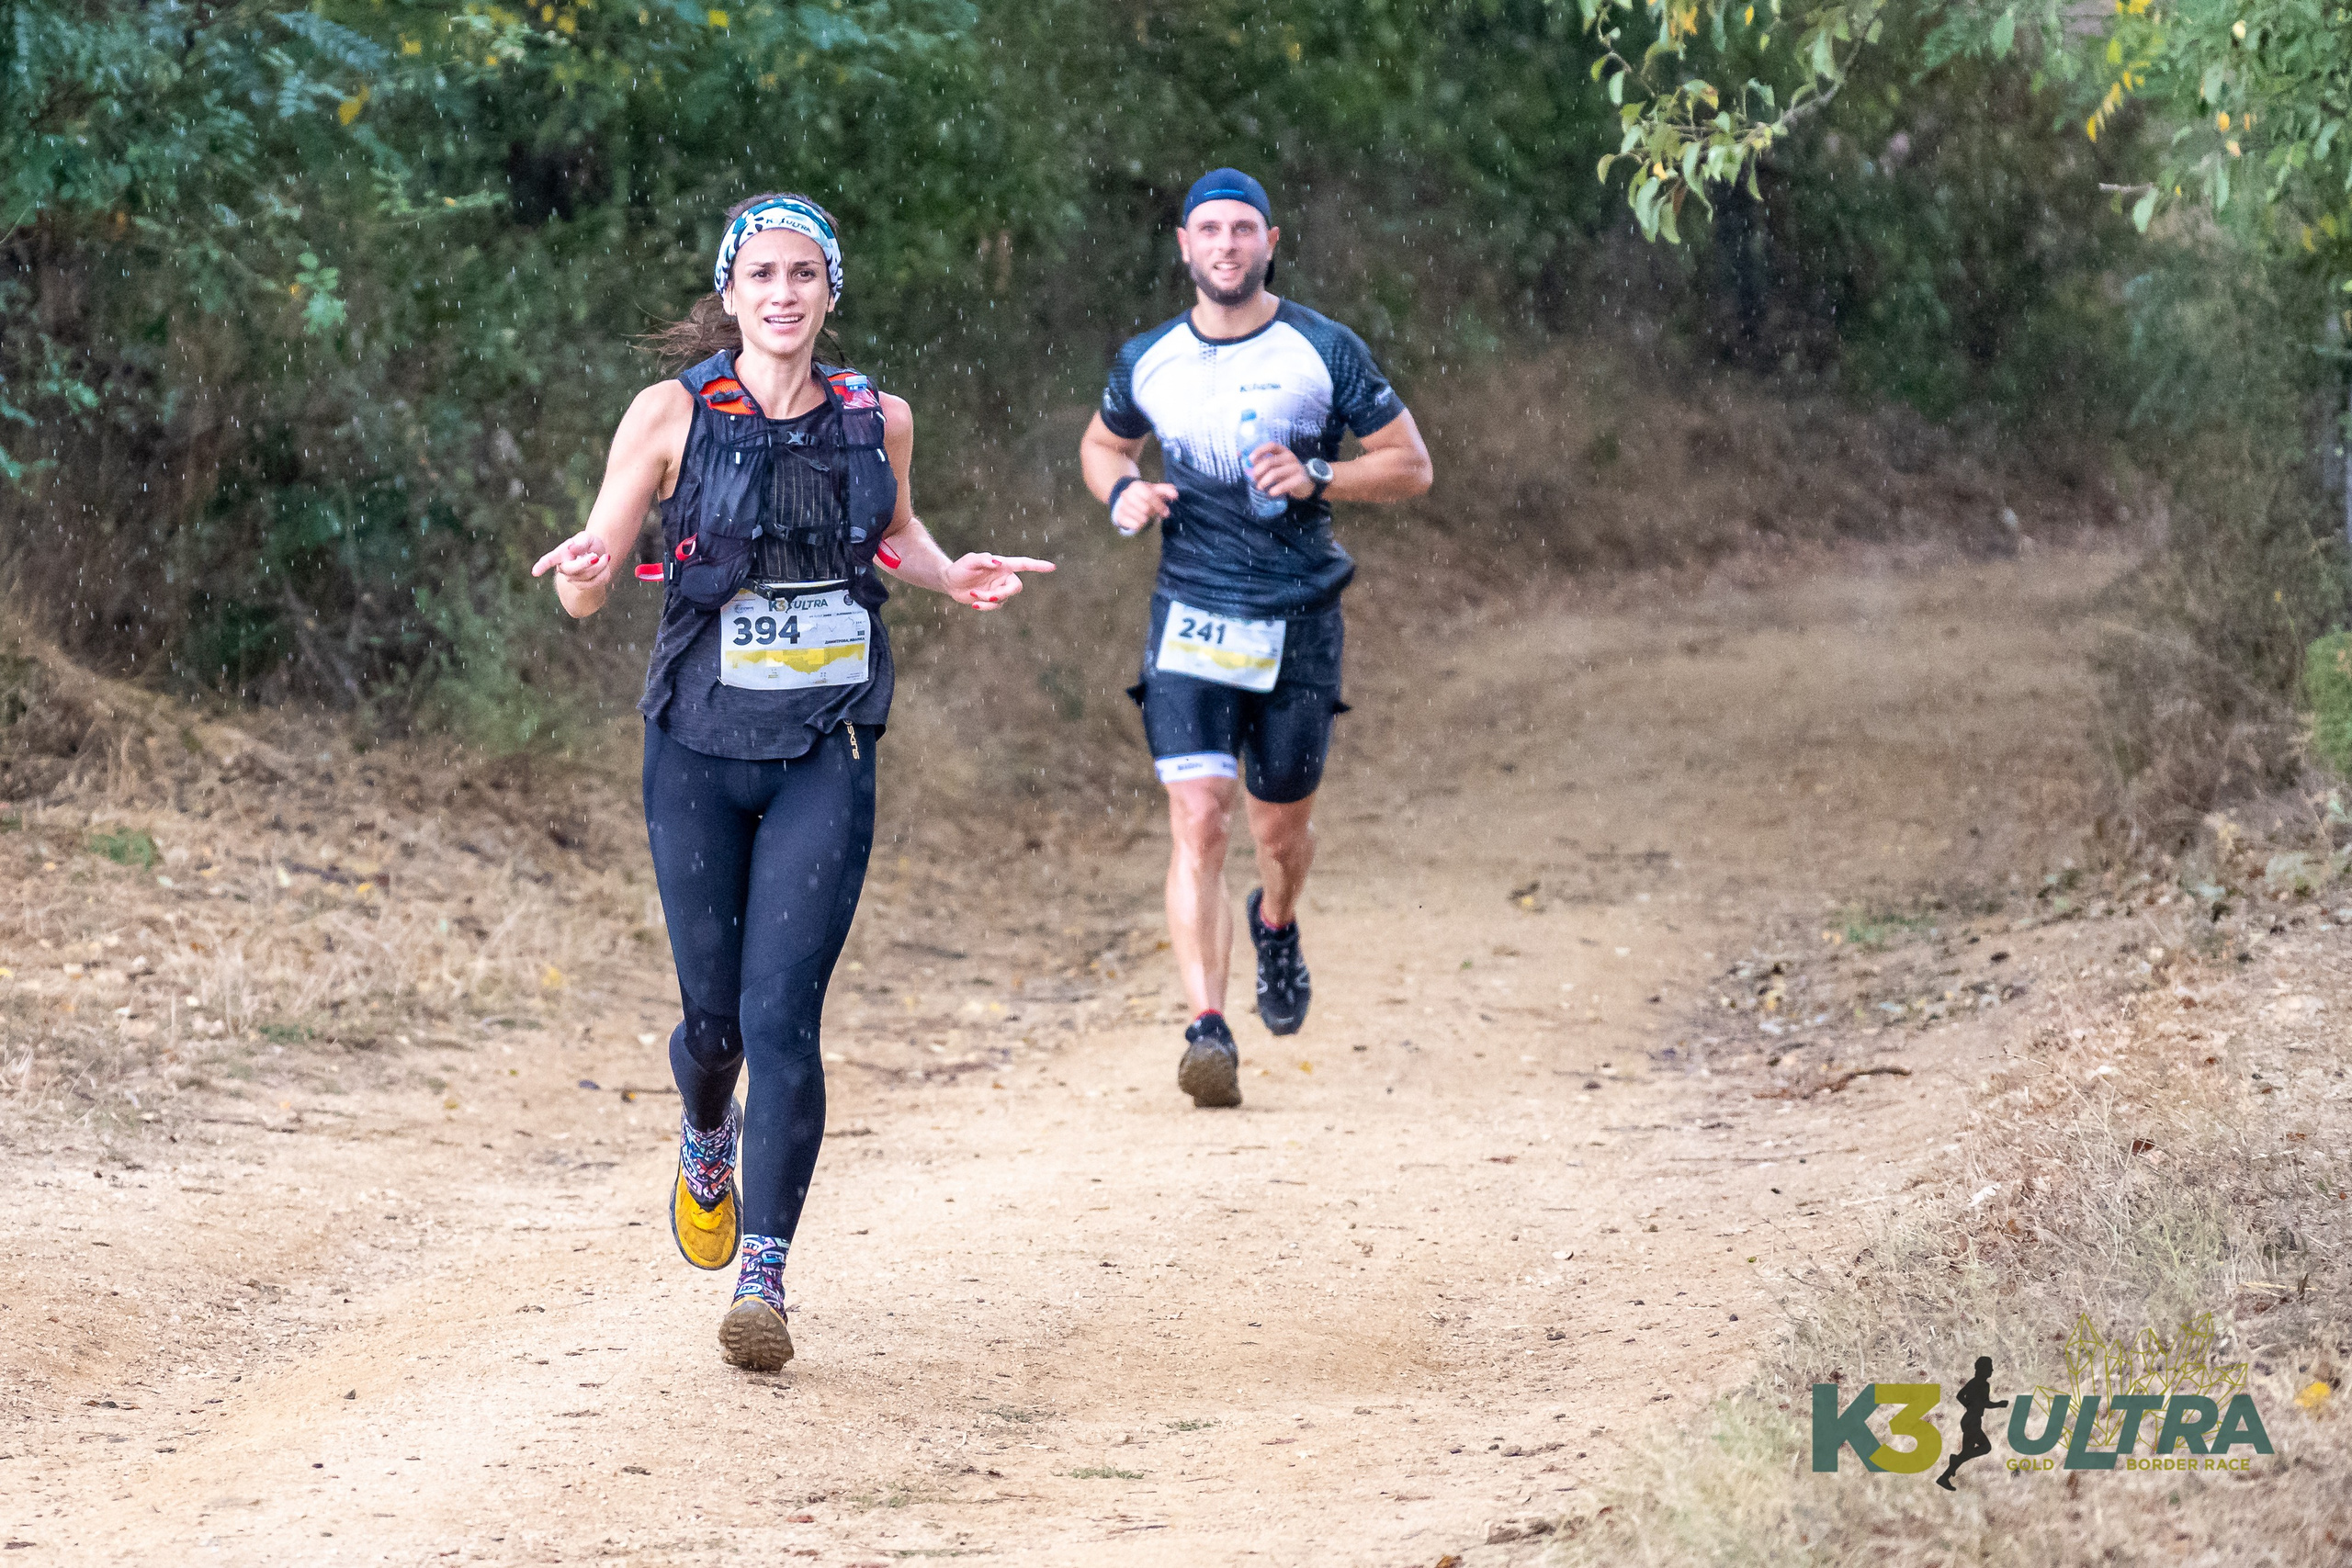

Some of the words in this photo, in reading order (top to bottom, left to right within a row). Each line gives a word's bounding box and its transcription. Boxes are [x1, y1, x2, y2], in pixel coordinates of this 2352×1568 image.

[786, 220, 811, 233] ULTRA
[795, 598, 829, 611] ULTRA
[732, 615, 800, 646] 394
[1179, 617, 1226, 645] 241
